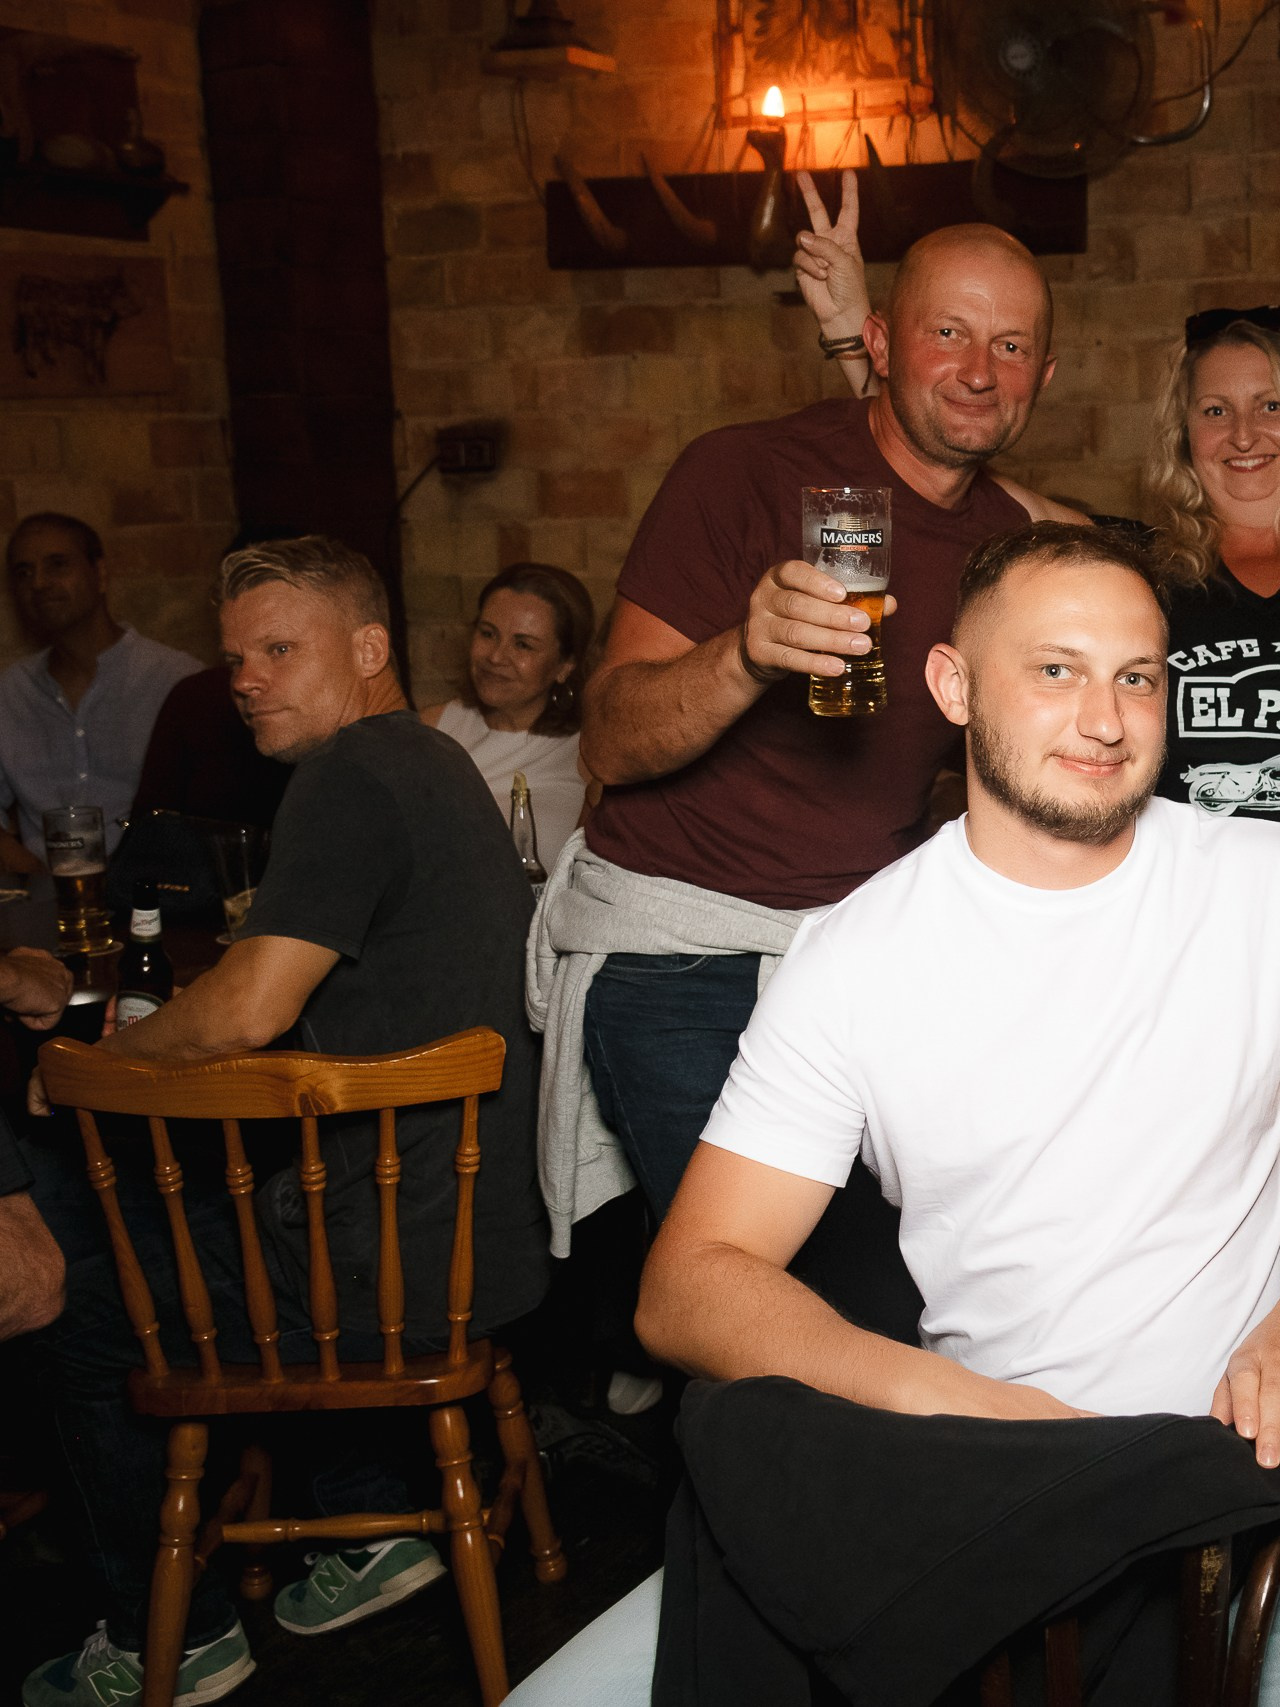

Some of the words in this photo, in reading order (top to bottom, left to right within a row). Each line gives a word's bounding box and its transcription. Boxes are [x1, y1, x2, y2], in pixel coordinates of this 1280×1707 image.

[822, 531, 883, 544] MAGNERS
[1167, 638, 1261, 672] CAFE
[1190, 687, 1245, 728] EL
